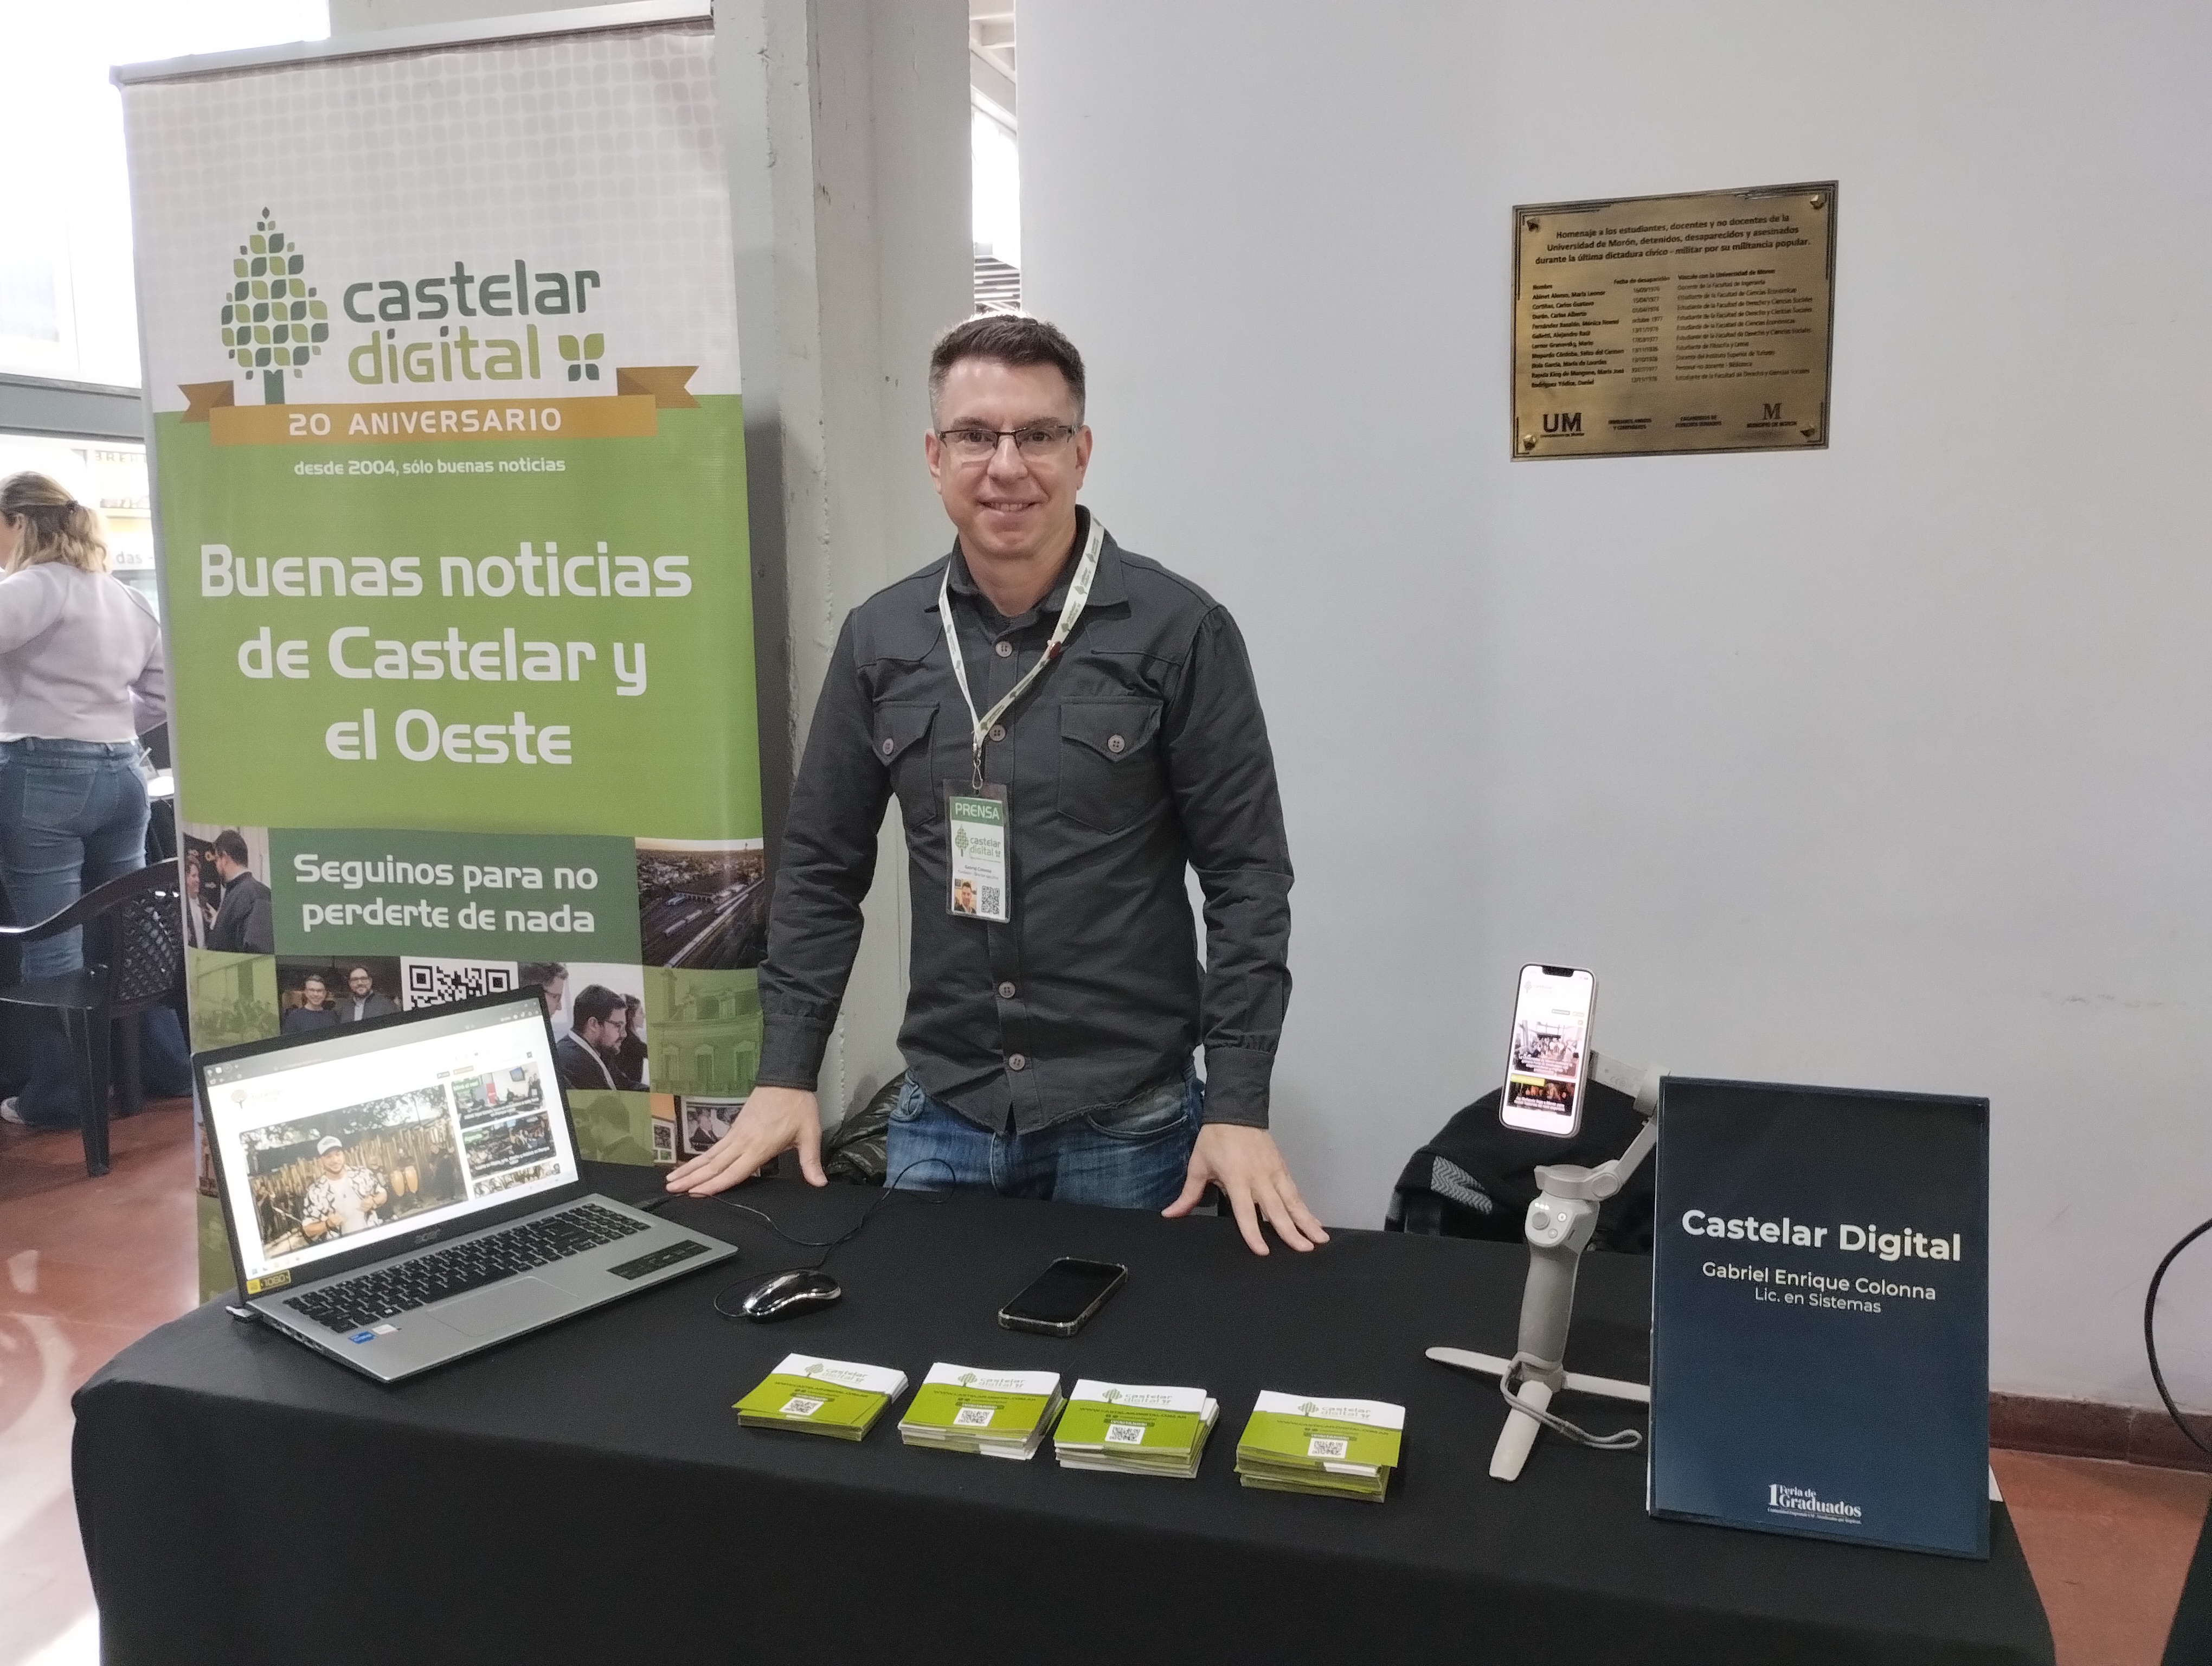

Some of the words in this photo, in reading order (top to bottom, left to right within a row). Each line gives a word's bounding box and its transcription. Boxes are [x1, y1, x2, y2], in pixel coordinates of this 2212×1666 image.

[1547, 243, 1594, 251] Universidad
[1609, 239, 1637, 247] Morón,
[1641, 234, 1683, 245] detenidos,
[1685, 230, 1744, 241] desaparecidos
[1753, 226, 1799, 236] asesinados
[1557, 229, 1596, 238] Homenaje
[1619, 225, 1669, 233] estudiantes,
[1670, 221, 1707, 230] docentes
[1729, 216, 1767, 225] docentes
[1535, 255, 1566, 264] durante
[1578, 251, 1603, 260] última
[1605, 249, 1643, 259] dictadura
[1675, 246, 1702, 254] militar
[1705, 245, 1719, 254] por
[1733, 239, 1773, 251] militancia
[343, 259, 601, 324] castelar
[348, 324, 542, 386] digital
[288, 413, 331, 436] 20
[349, 408, 562, 434] ANIVERSARIO
[1543, 413, 1582, 433] UM
[1764, 403, 1782, 420] M
[294, 461, 344, 476] desde
[349, 460, 400, 476] 2004,
[402, 460, 434, 474] sólo
[438, 459, 494, 474] buenas
[498, 457, 566, 473] noticias
[200, 543, 424, 598] Buenas
[439, 541, 693, 598] noticias
[237, 626, 310, 679] de
[328, 626, 596, 681] Castelar
[613, 643, 648, 696] y
[325, 708, 377, 760] el
[395, 709, 572, 765] Oeste
[955, 803, 1000, 820] PRENSA
[970, 837, 1001, 848] castelar
[970, 846, 994, 856] digital
[293, 853, 455, 890] Seguinos
[463, 862, 543, 893] para
[555, 866, 598, 890] no
[303, 898, 449, 932] perderte
[457, 902, 496, 931] de
[505, 902, 595, 933] nada
[1682, 1209, 1828, 1248] Castelar
[1840, 1223, 1961, 1261] Digital
[264, 1275, 286, 1287] 1080
[1702, 1262, 1769, 1283] Gabriel
[1776, 1269, 1850, 1292] Enrique
[1855, 1278, 1936, 1301] Colonna
[1755, 1287, 1779, 1302] Lic.
[1785, 1292, 1804, 1304] en
[1809, 1292, 1881, 1313] Sistemas
[1769, 1484, 1779, 1506] 1
[1779, 1494, 1861, 1517] Graduados
[1805, 1489, 1816, 1497] de
